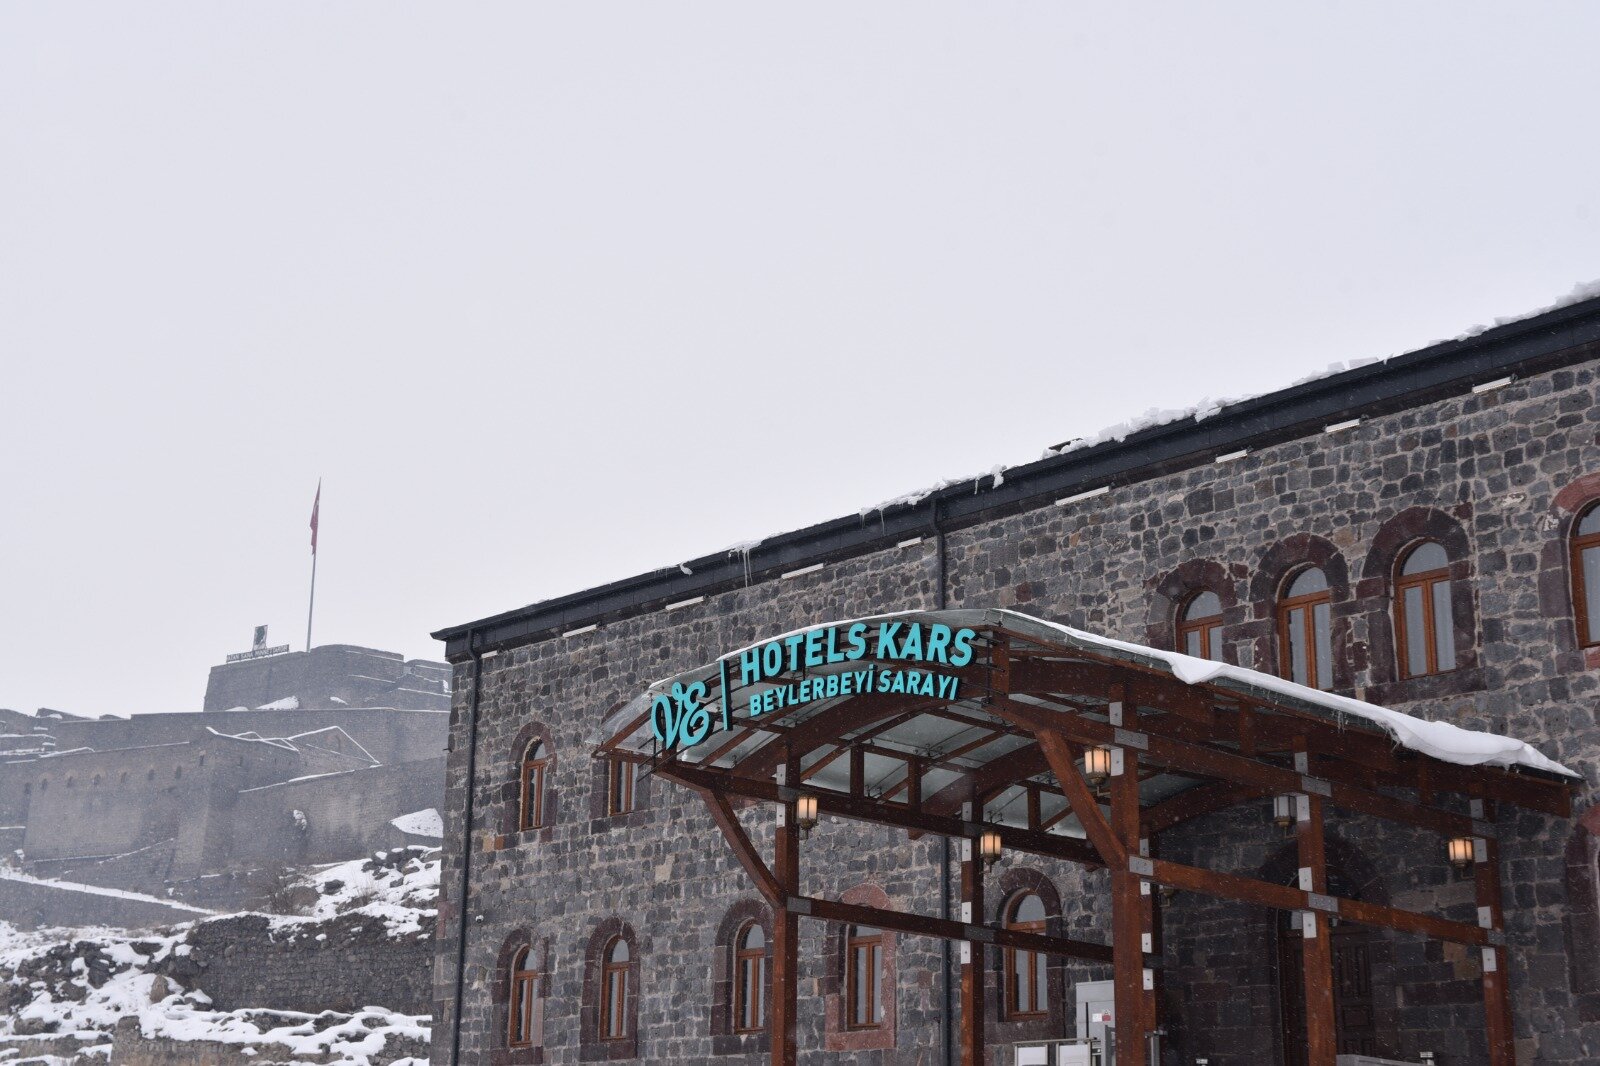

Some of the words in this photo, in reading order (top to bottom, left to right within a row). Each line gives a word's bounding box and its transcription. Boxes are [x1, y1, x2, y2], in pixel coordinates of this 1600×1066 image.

[740, 622, 867, 687] HOTELS
[877, 621, 976, 667] KARS
[749, 664, 874, 716] BEYLERBEYİ
[878, 670, 959, 700] SARAYI
